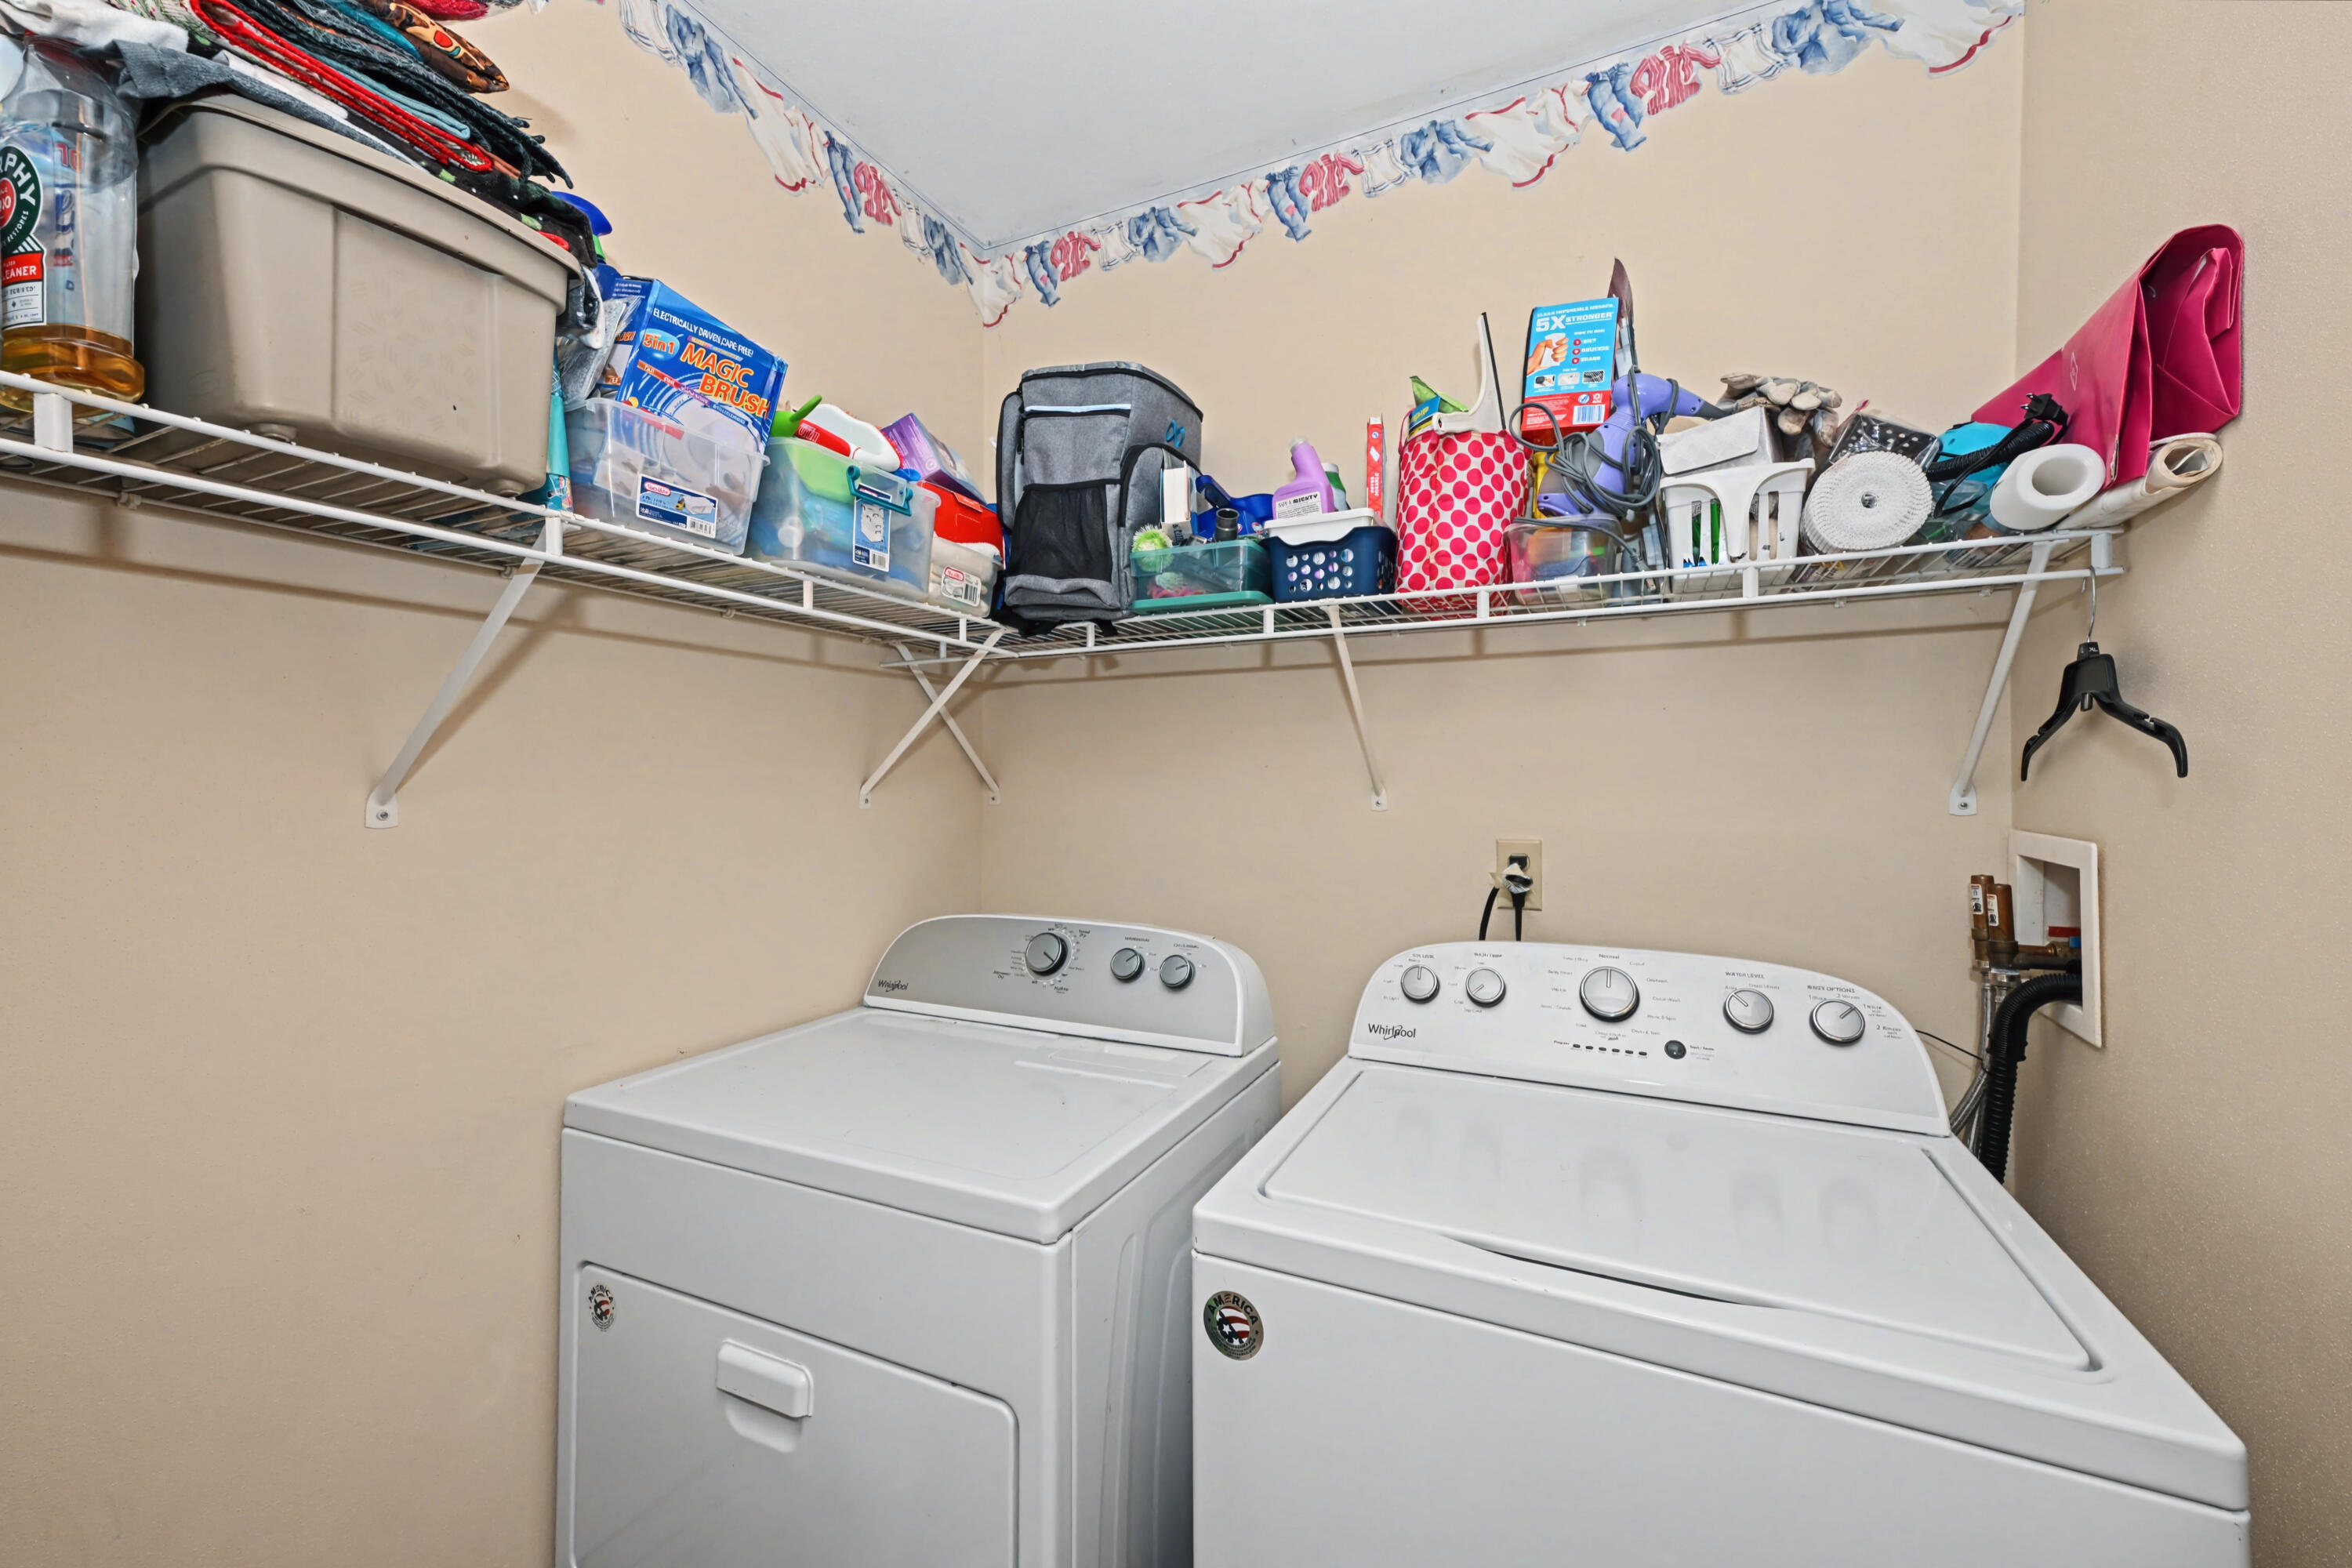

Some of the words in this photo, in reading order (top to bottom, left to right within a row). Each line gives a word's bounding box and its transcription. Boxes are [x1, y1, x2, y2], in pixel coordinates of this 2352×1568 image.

[653, 307, 699, 334] ELECTRICALLY
[1535, 314, 1566, 332] 5X
[680, 342, 754, 388] MAGIC
[699, 372, 771, 419] BRUSH
[1368, 1023, 1417, 1040] Whirlpool
[1207, 1293, 1259, 1326] AMERICA
